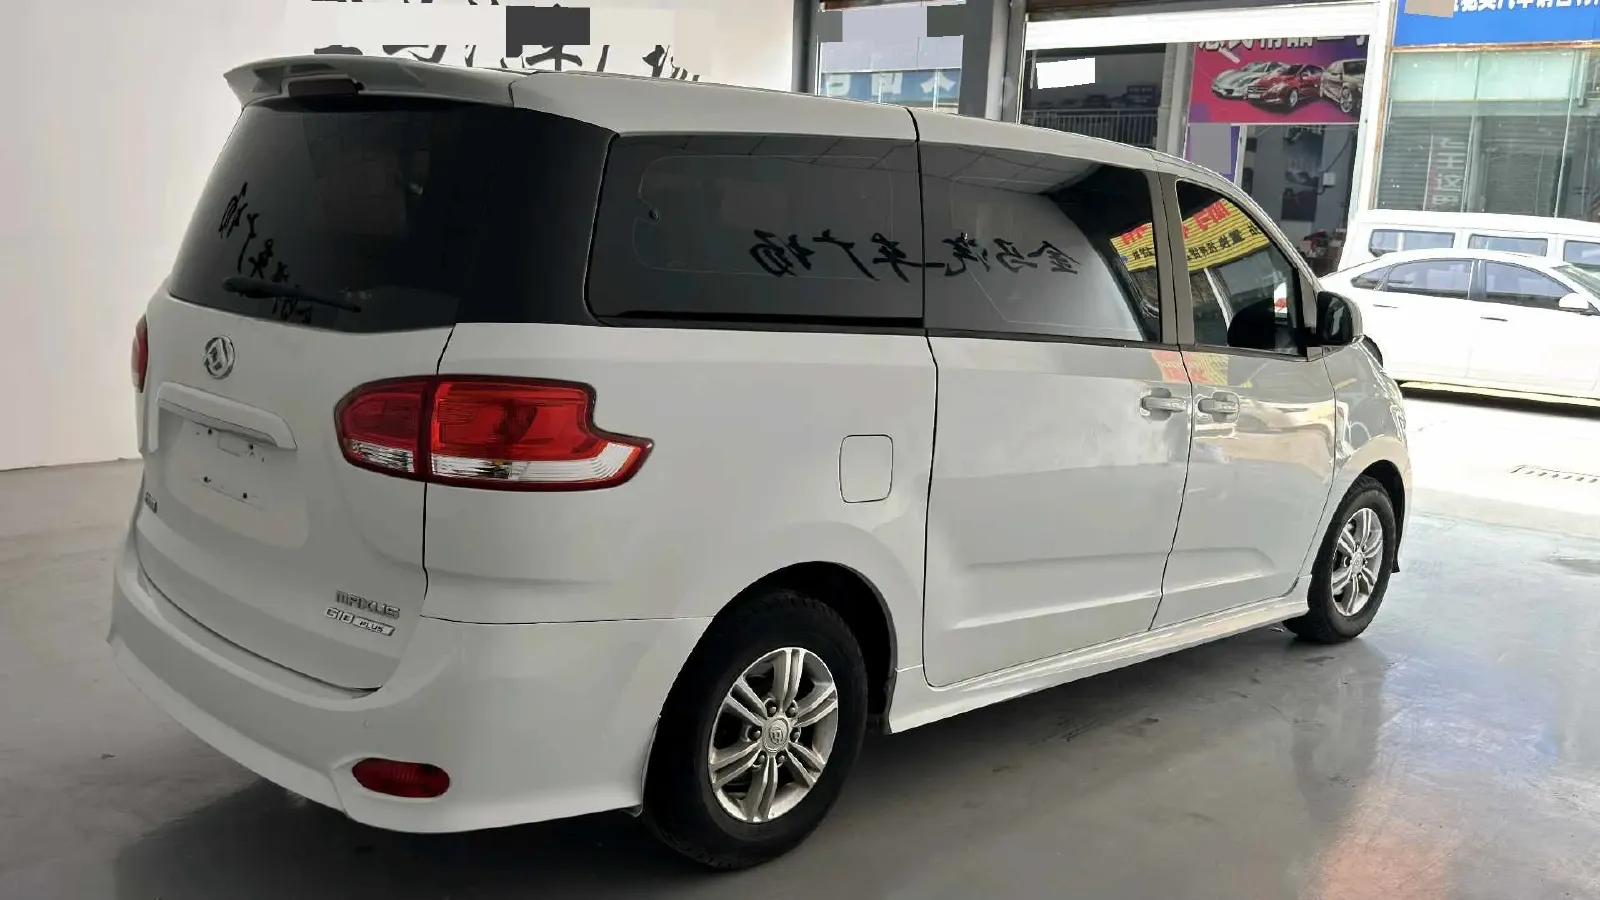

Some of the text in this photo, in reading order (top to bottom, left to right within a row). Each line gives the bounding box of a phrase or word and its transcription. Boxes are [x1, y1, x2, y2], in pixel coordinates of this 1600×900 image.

[335, 590, 401, 620] MAXUS
[325, 606, 384, 633] G10 PLUS
